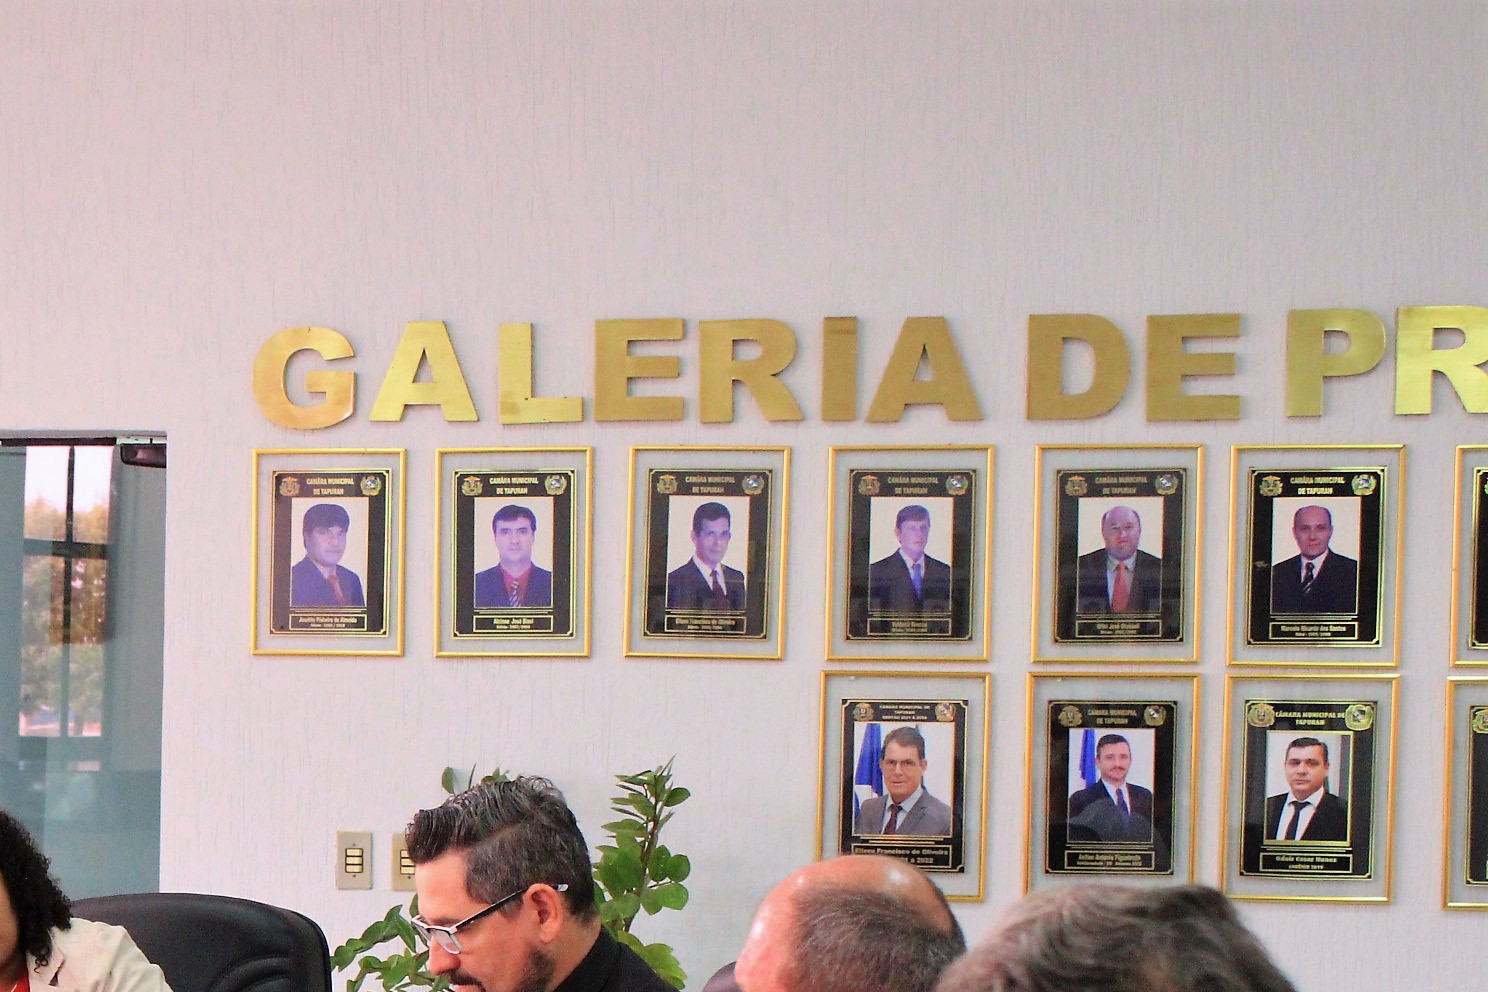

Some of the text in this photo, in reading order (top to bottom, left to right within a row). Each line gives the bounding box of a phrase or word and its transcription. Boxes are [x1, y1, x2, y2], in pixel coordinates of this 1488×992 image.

[252, 305, 1488, 431] GALERIA DE PR
